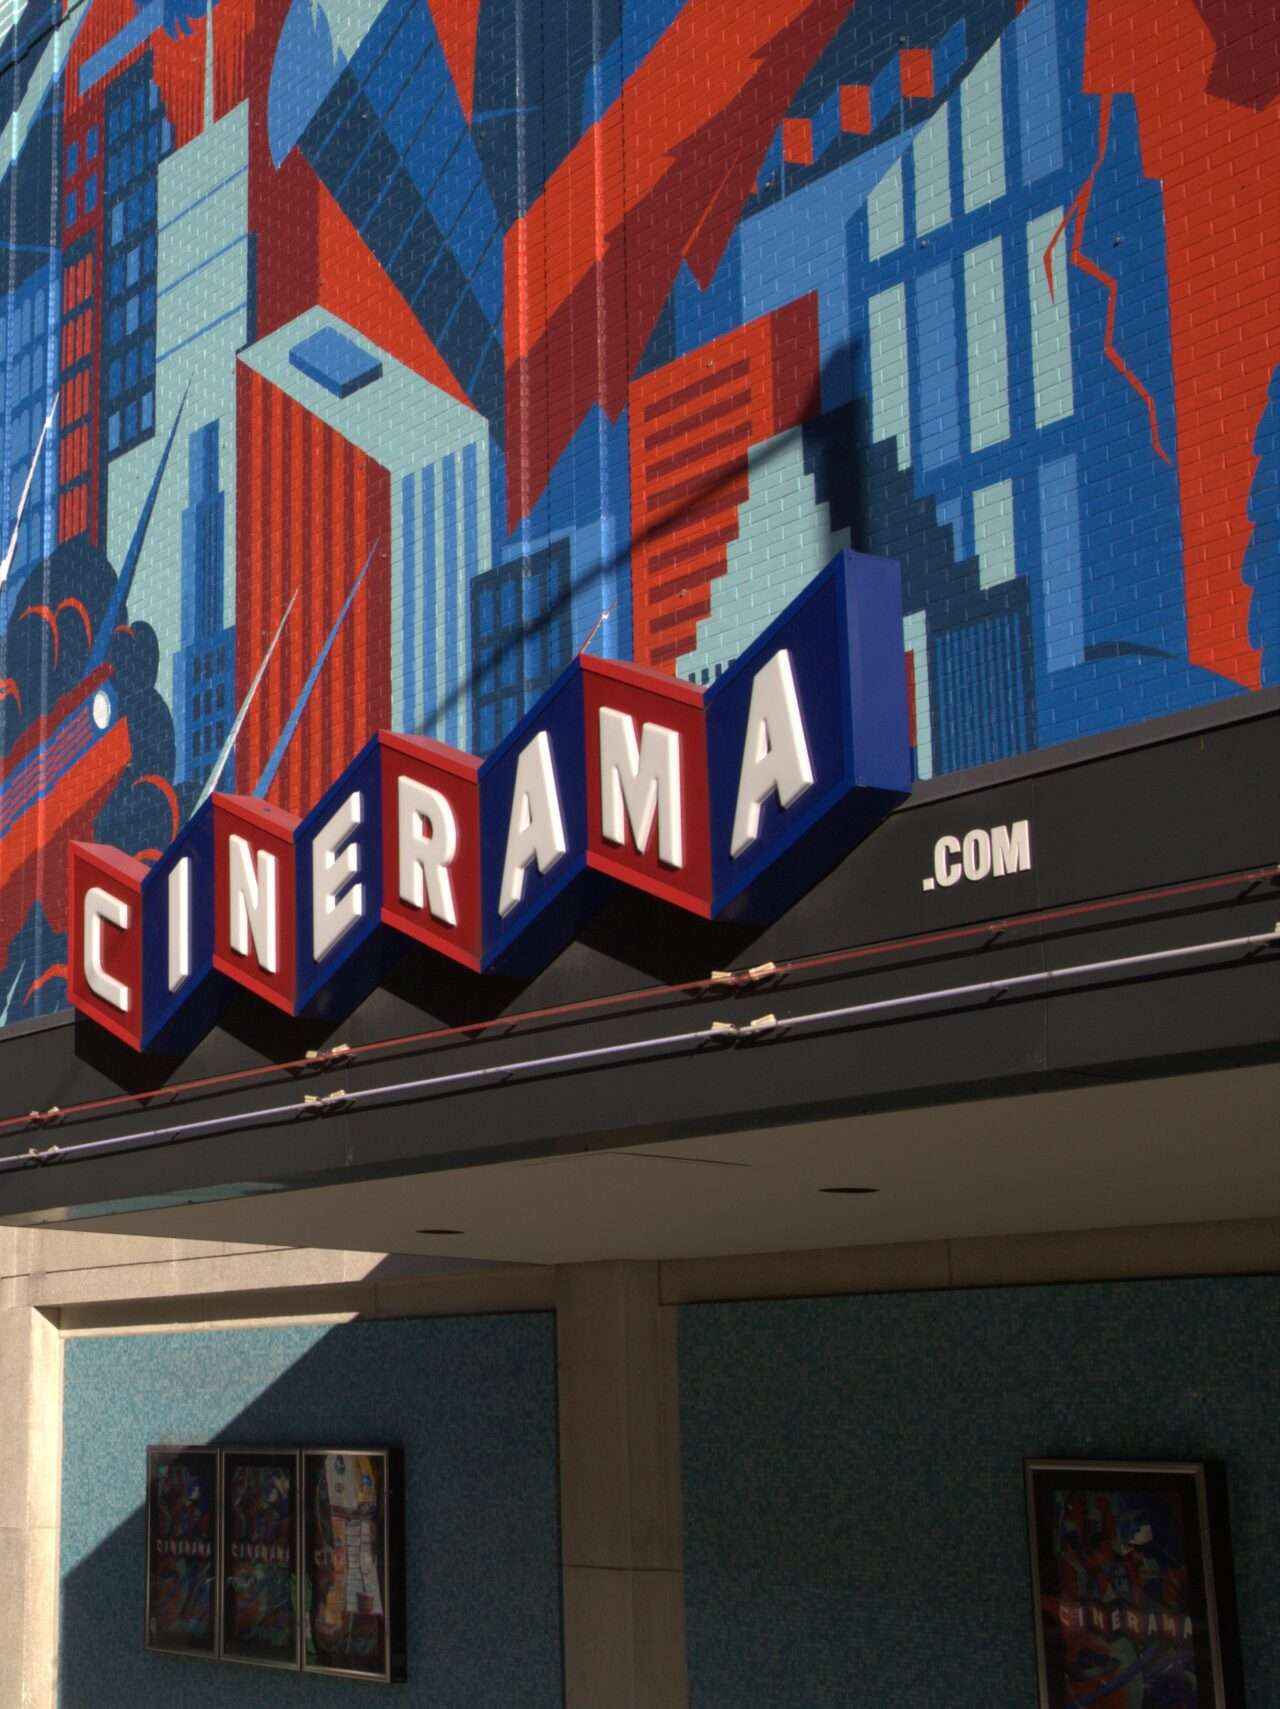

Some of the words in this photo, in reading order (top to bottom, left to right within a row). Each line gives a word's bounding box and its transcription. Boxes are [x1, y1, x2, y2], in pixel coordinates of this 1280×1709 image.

[84, 648, 815, 1012] CINERAMA
[921, 819, 1031, 892] .COM
[1058, 1605, 1193, 1639] CINERAMA
